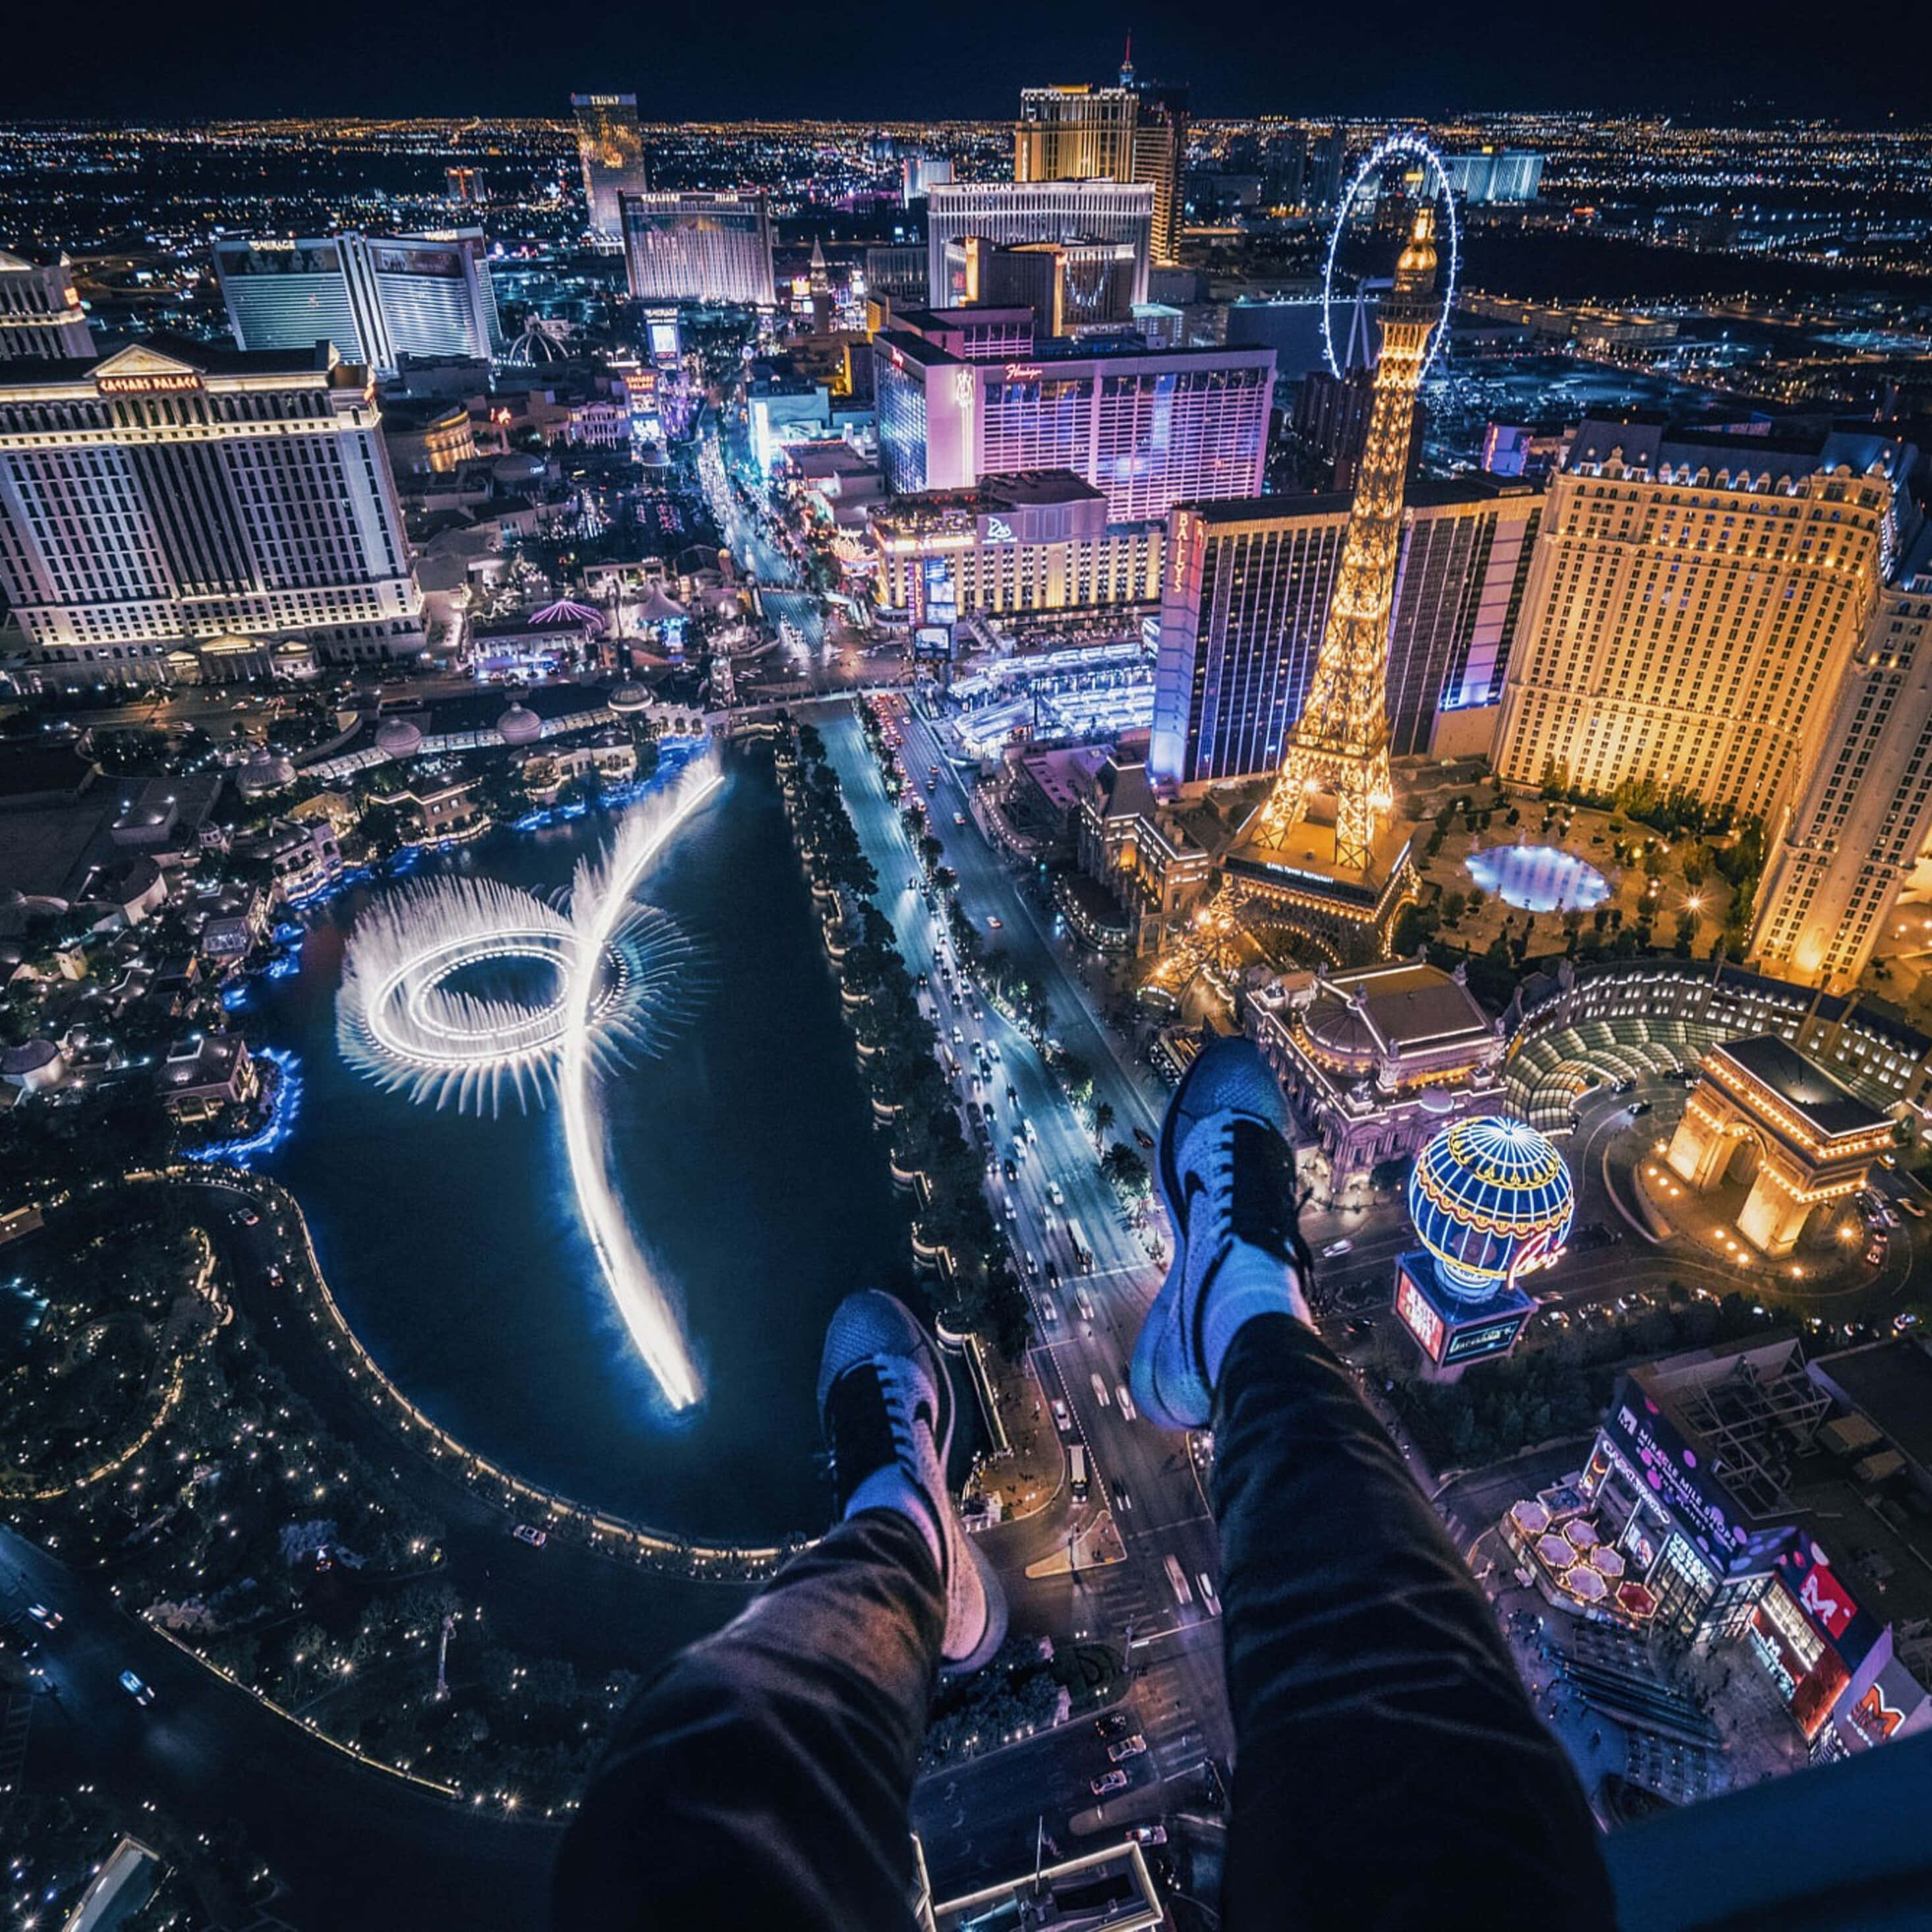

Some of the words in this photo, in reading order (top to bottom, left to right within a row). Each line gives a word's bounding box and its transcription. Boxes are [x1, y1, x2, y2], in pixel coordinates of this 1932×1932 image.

[99, 379, 152, 392] CAESARS
[152, 376, 198, 390] PALACE
[1638, 1429, 1679, 1478] MIRACLE
[1680, 1476, 1703, 1507] MILE
[1704, 1506, 1737, 1548] SHOPS
[1675, 1494, 1707, 1533] PLANET
